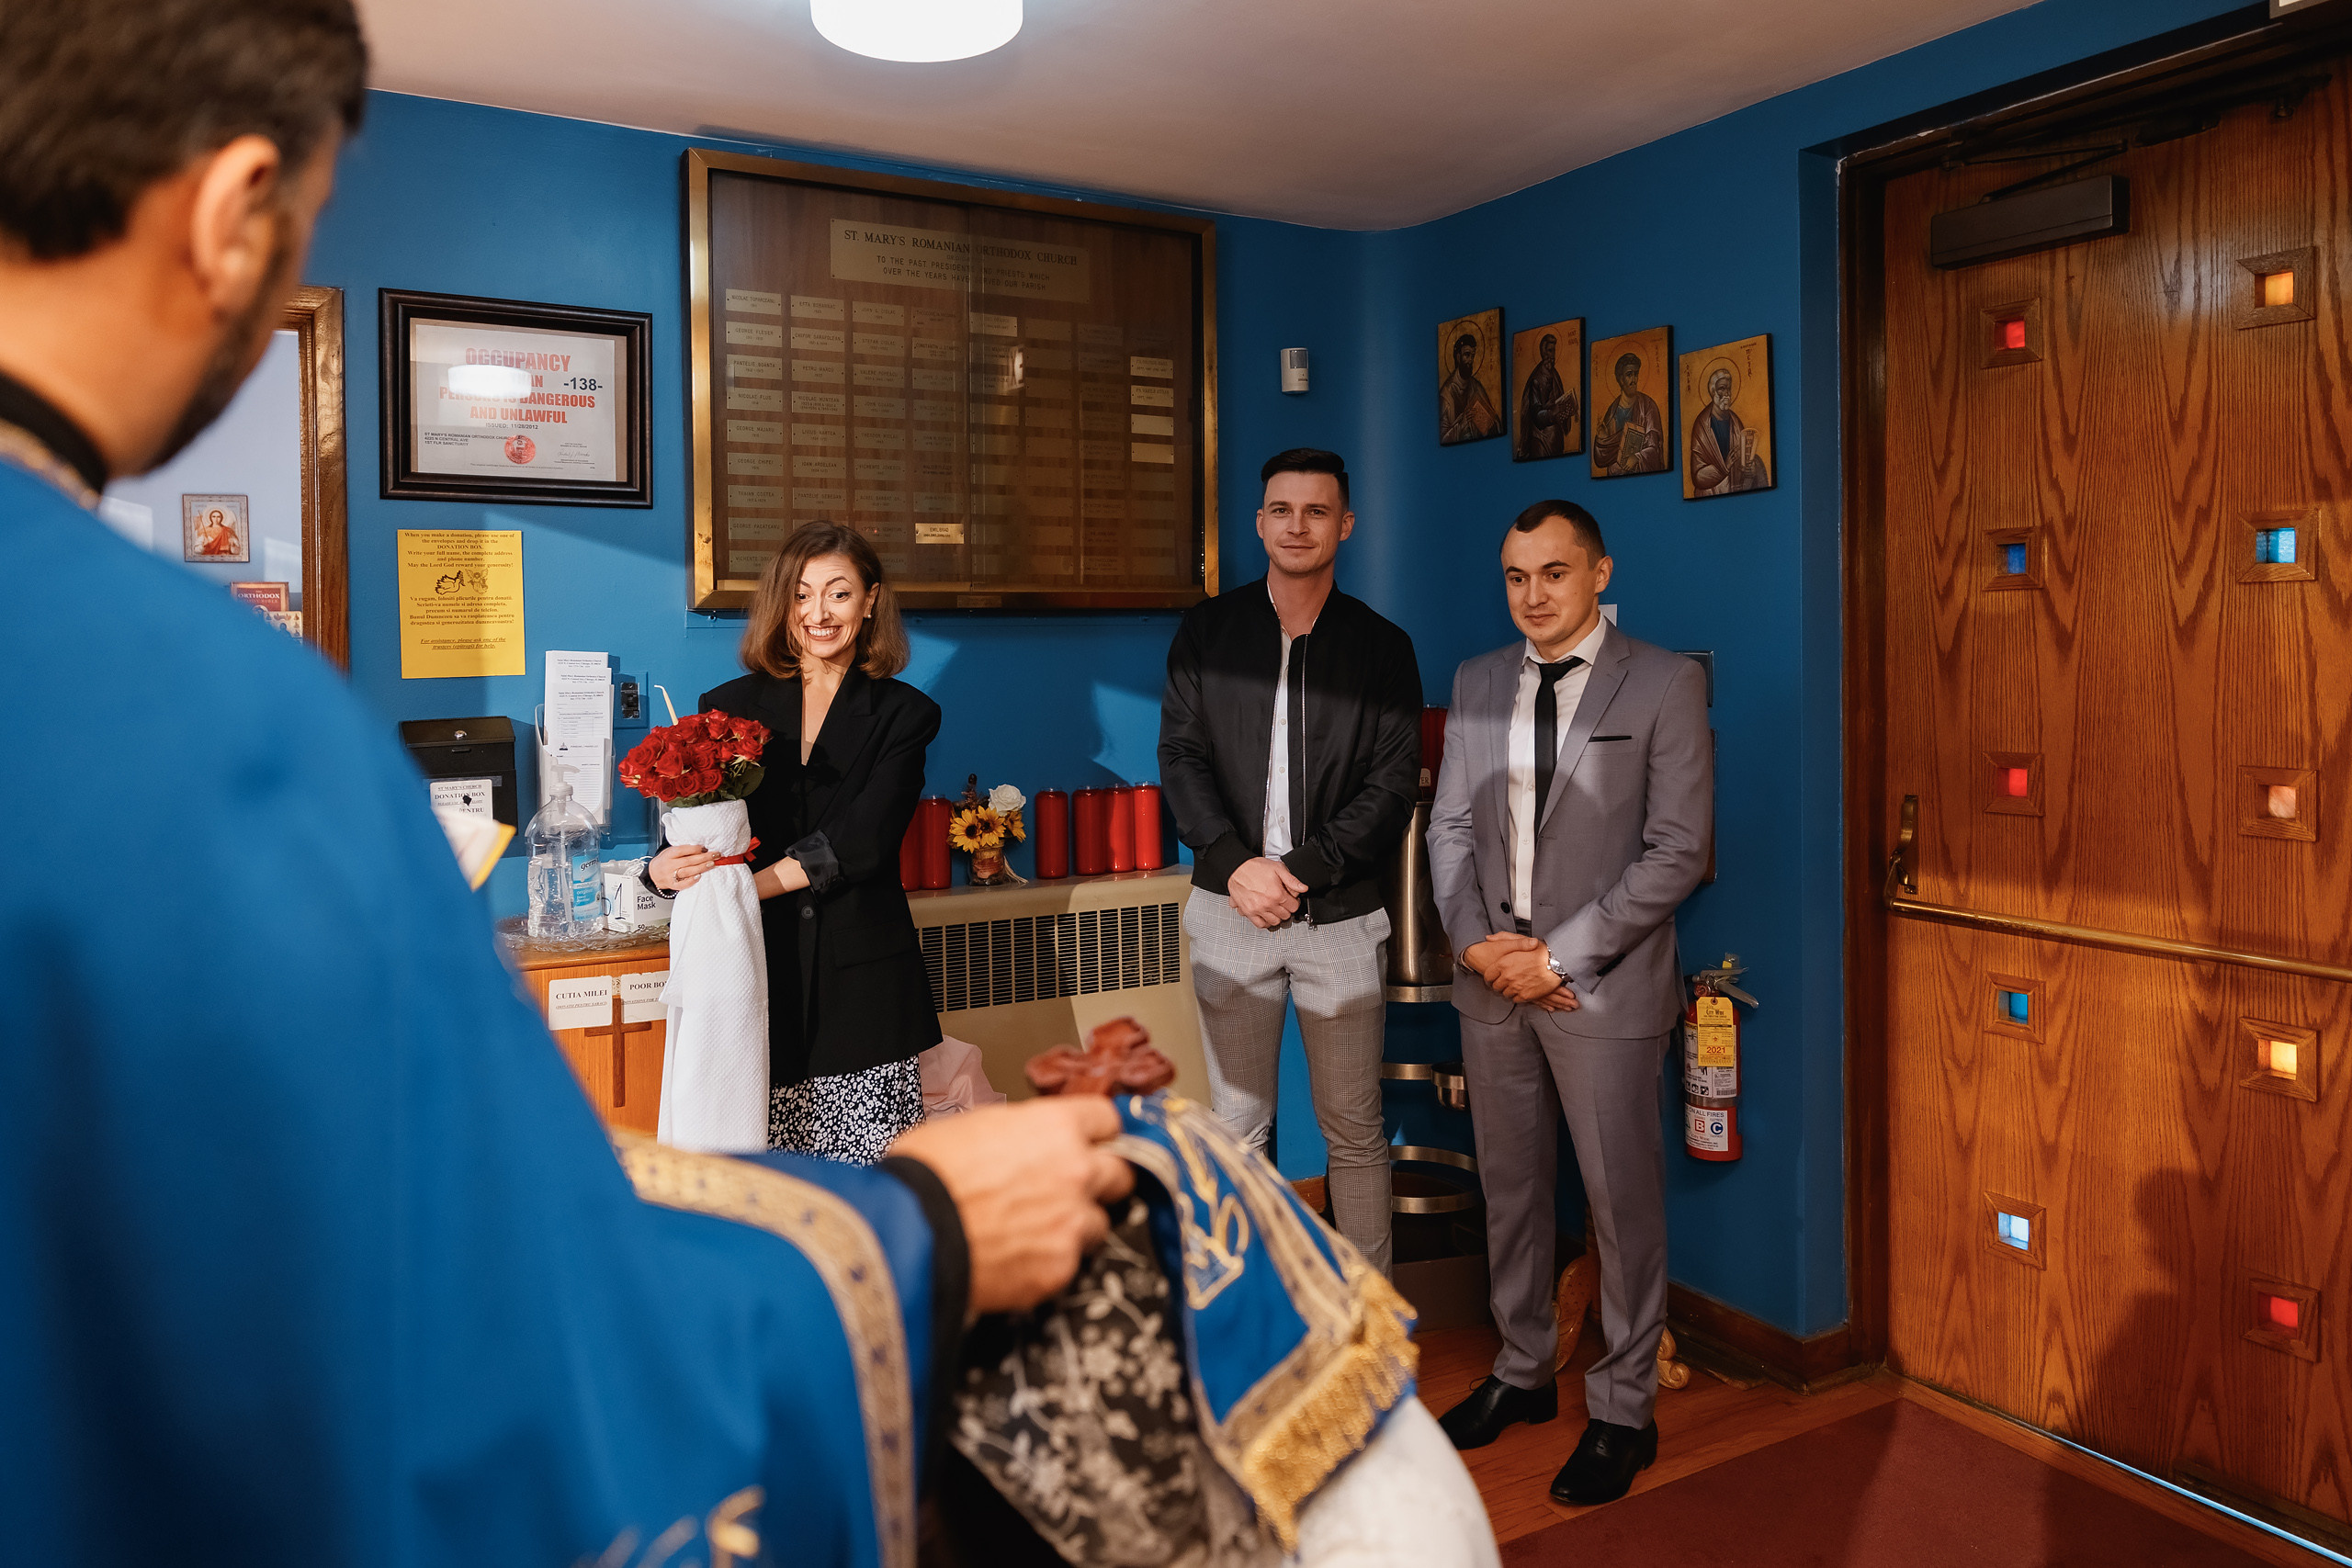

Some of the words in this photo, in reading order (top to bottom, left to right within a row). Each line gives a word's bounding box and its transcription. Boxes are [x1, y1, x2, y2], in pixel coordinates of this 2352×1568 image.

[843, 230, 860, 242] ST.
[865, 231, 906, 246] MARY'S
[911, 237, 970, 254] ROMANIAN
[1036, 252, 1078, 265] CHURCH
[876, 255, 886, 264] TO
[889, 256, 904, 265] THE
[909, 258, 927, 268] PAST
[996, 267, 1025, 279] PRIESTS
[1029, 271, 1050, 281] WHICH
[883, 266, 902, 276] OVER
[906, 269, 921, 278] THE
[924, 271, 947, 281] YEARS
[951, 274, 970, 283] HAVE
[1004, 279, 1018, 288] OUR
[1022, 281, 1046, 291] PARISH
[465, 347, 571, 373] OCCUPANCY
[563, 377, 604, 391] -138-
[520, 392, 595, 408] DANGEROUS
[470, 406, 497, 419] AND
[500, 408, 568, 424] UNLAWFUL
[637, 895, 654, 903] Face
[637, 901, 656, 910] Mask
[1696, 1121, 1704, 1132] B
